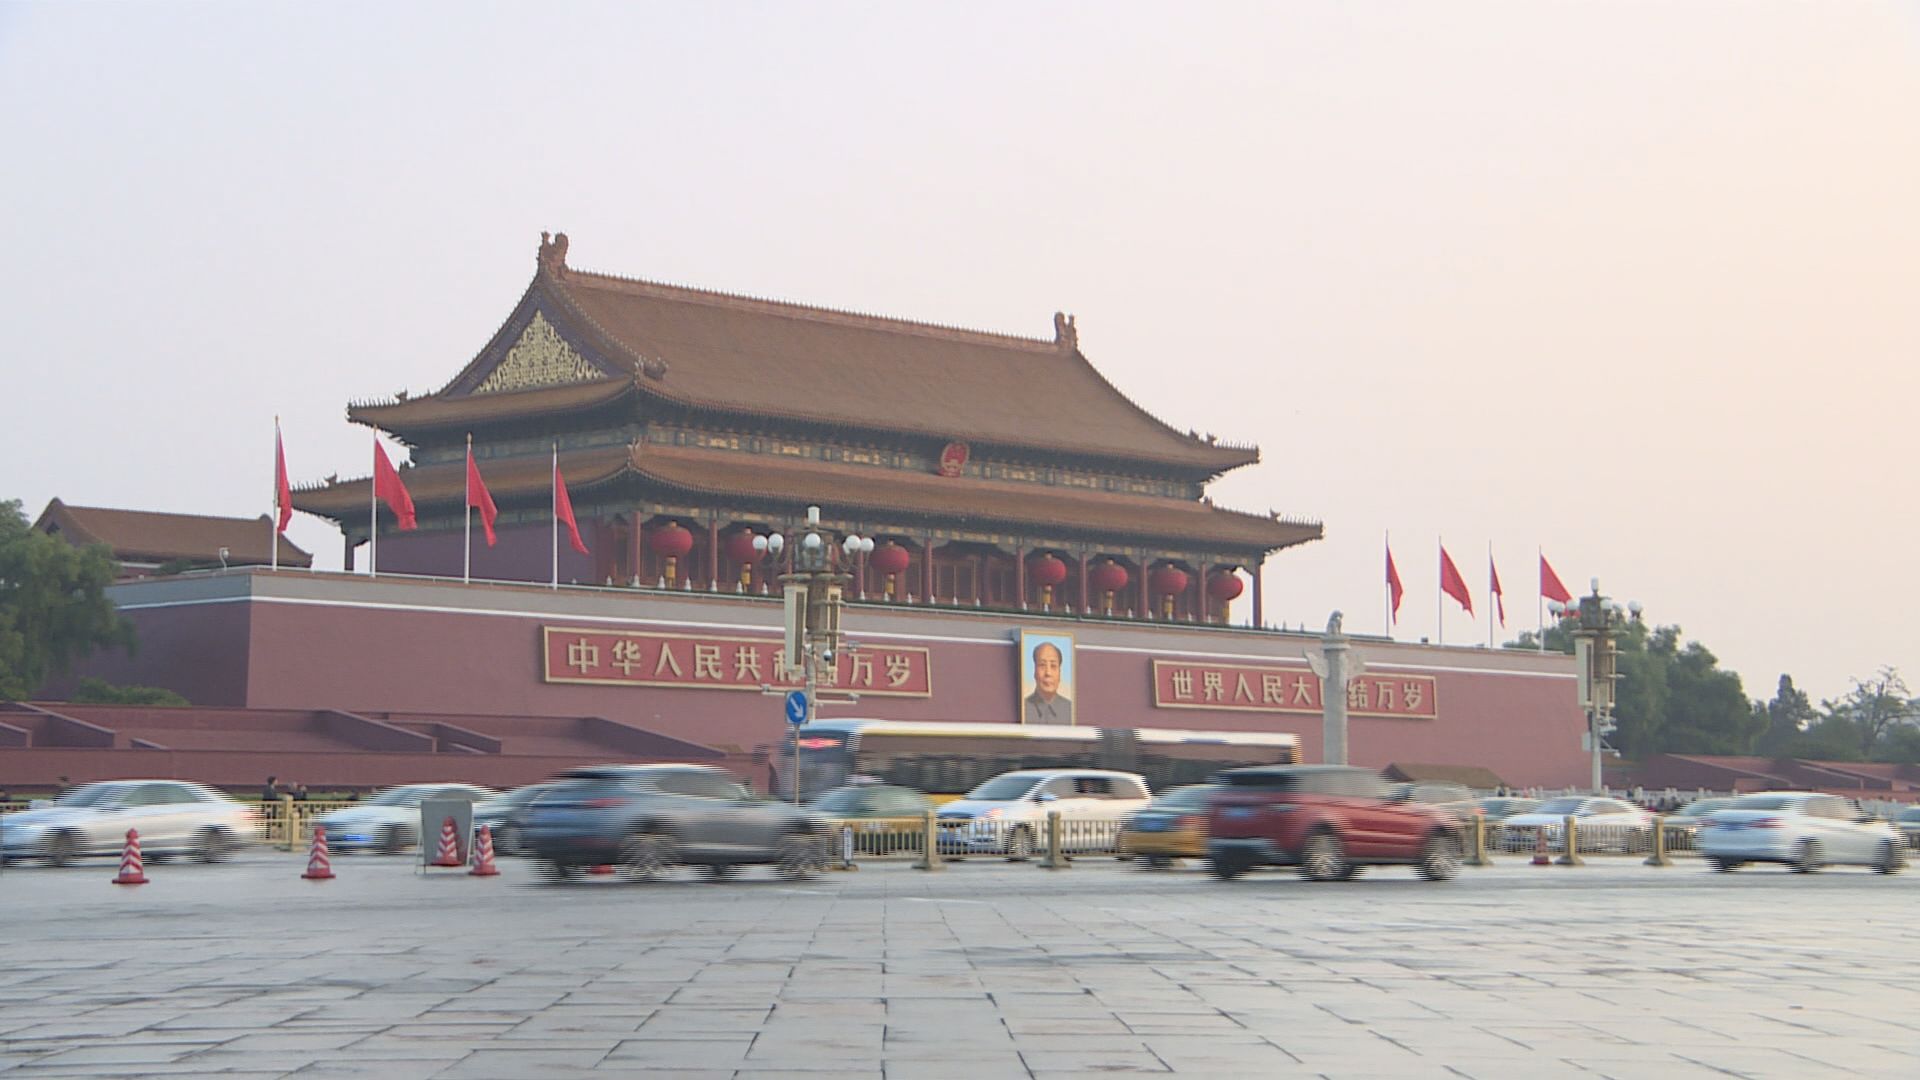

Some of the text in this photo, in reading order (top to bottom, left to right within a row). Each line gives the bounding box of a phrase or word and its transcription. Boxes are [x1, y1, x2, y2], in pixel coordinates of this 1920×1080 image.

[1172, 670, 1423, 711] 世界人民大结万岁
